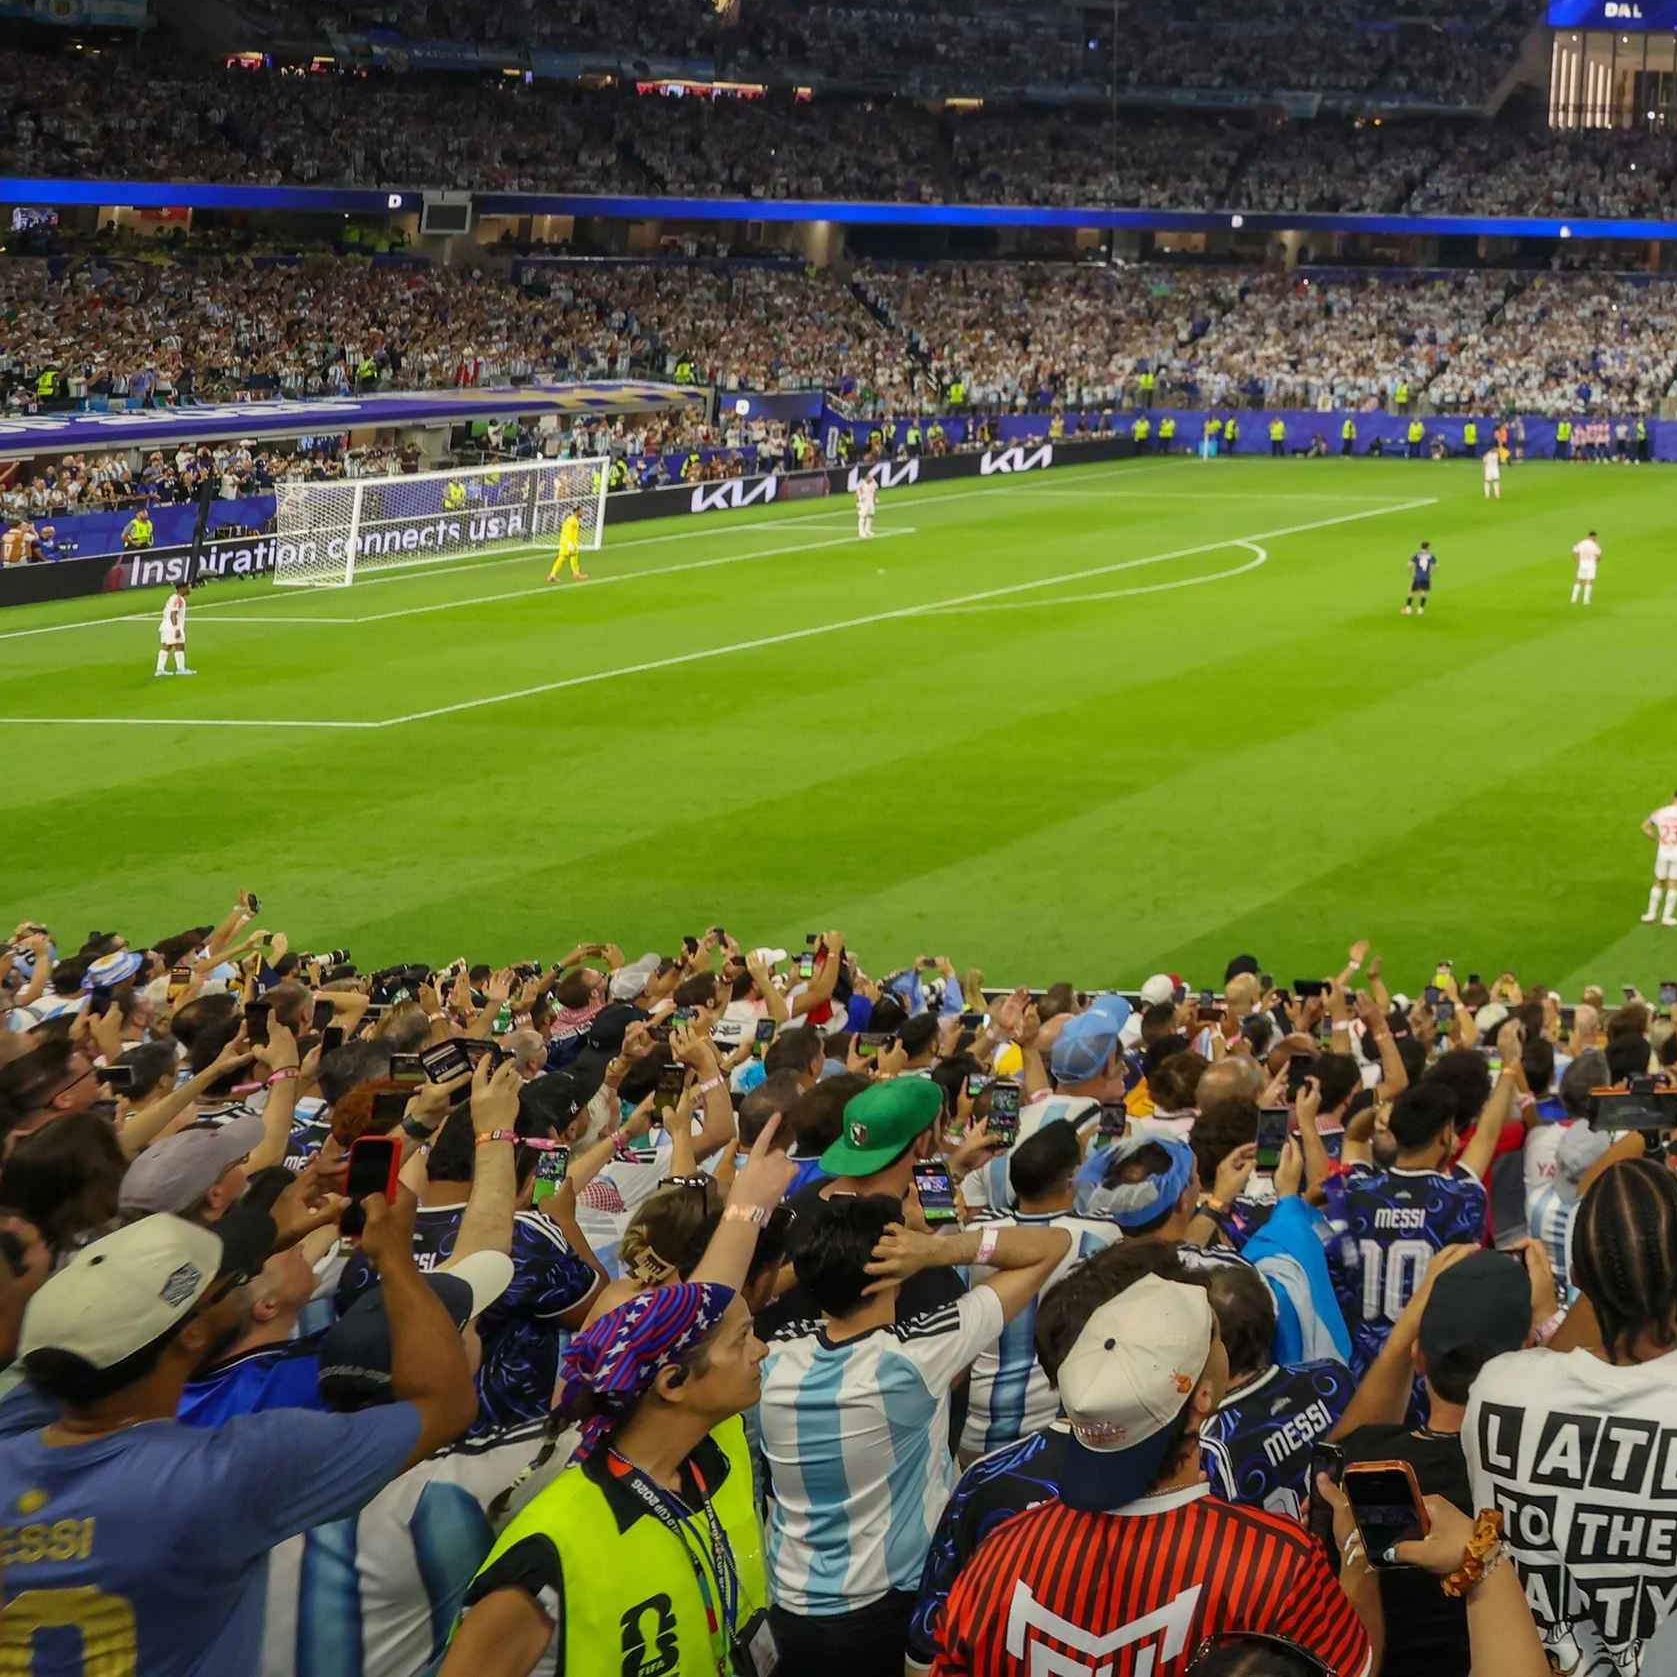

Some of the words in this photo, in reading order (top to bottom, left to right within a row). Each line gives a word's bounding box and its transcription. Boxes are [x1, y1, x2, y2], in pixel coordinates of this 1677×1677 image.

[1374, 1207, 1426, 1229] MESSI
[1359, 1238, 1434, 1324] 10
[1262, 1398, 1334, 1468] MESSI
[0, 1516, 97, 1566] ESSI
[1496, 1492, 1552, 1547] TO
[1576, 1511, 1677, 1561] THE
